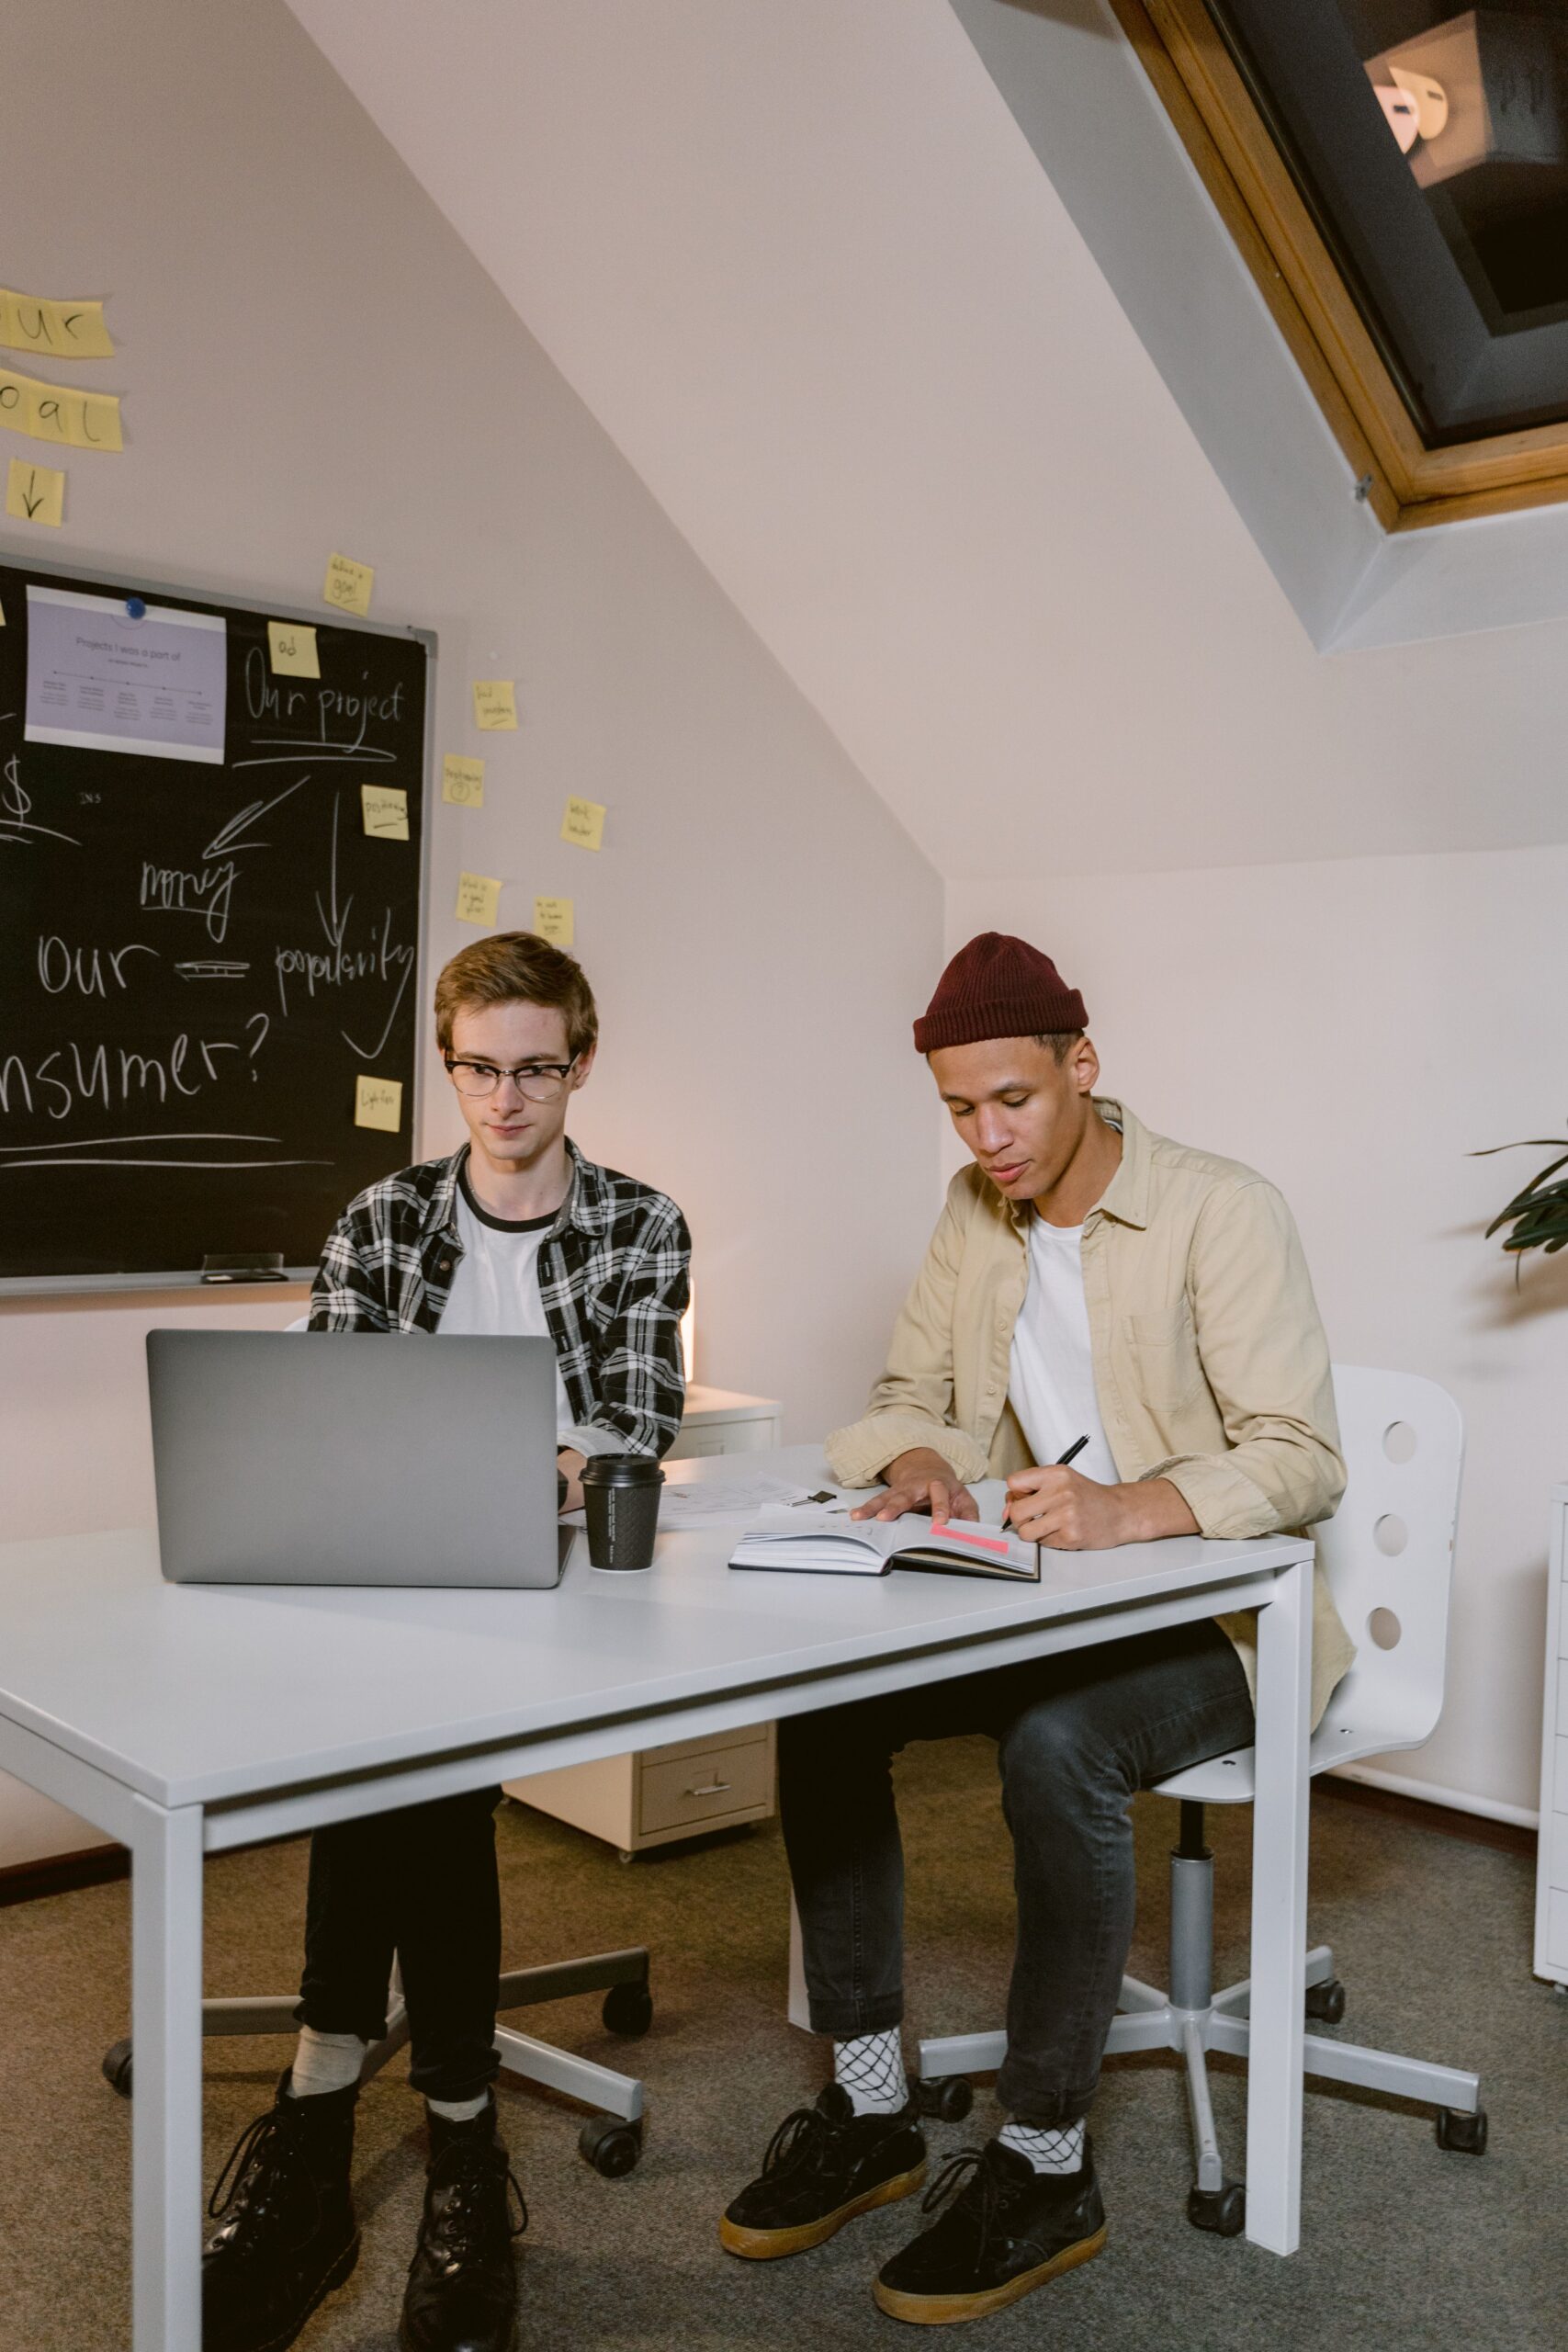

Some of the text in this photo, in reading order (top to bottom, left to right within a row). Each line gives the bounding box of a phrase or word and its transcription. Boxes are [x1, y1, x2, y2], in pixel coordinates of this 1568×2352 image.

[0, 308, 85, 345] ur
[75, 637, 112, 651] Projects
[120, 646, 140, 656] was
[150, 650, 170, 661] part
[171, 651, 181, 662] of
[245, 646, 404, 754] Our project
[276, 906, 413, 1059] popularity
